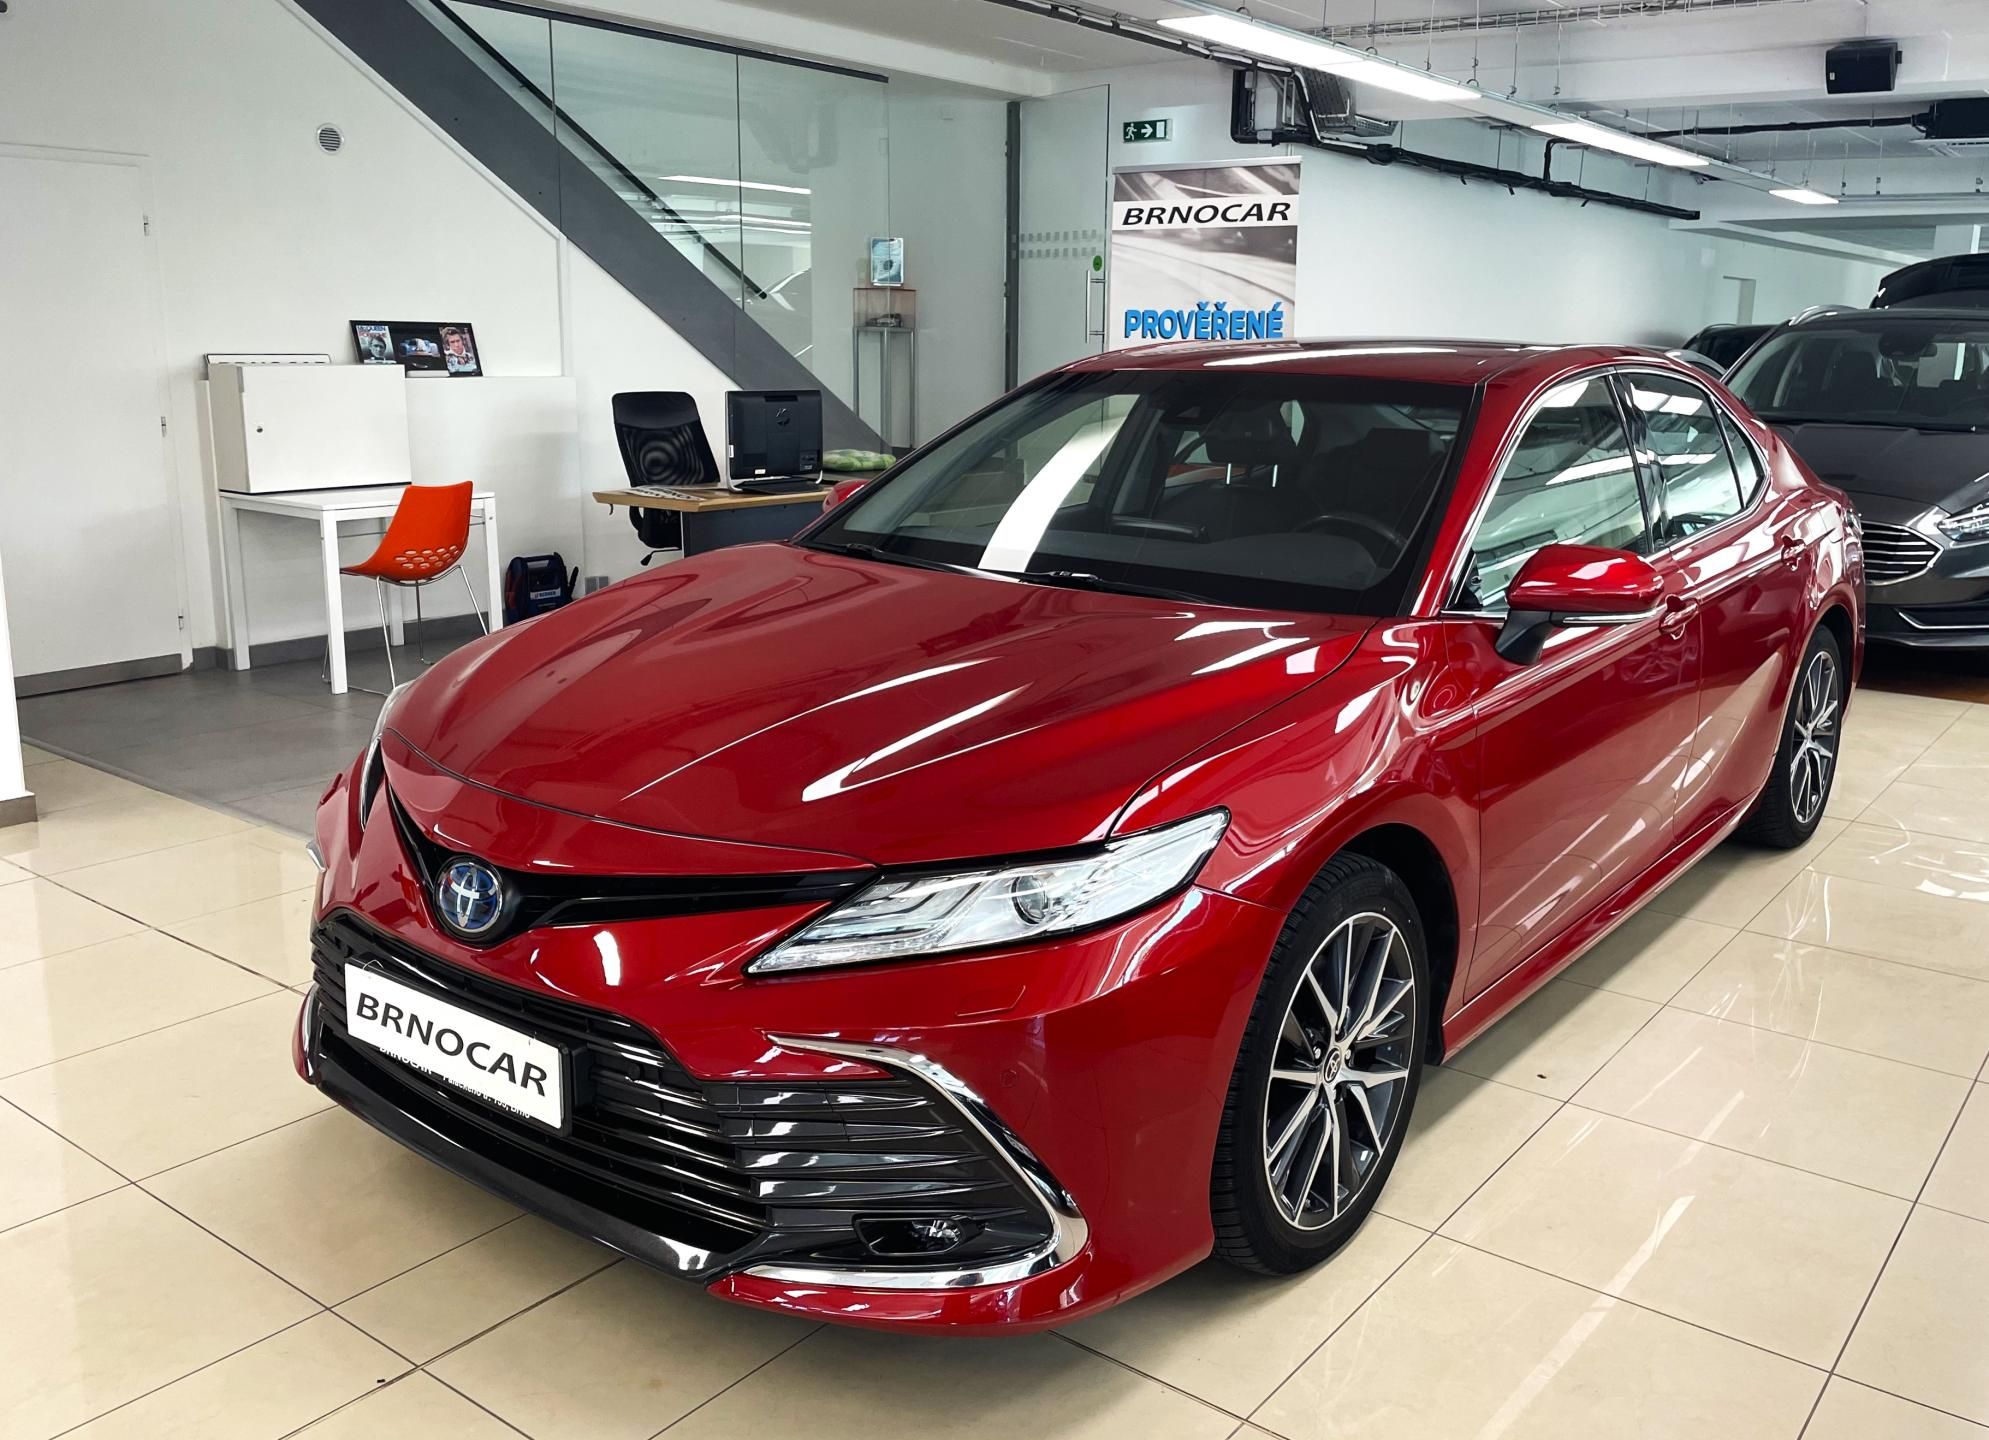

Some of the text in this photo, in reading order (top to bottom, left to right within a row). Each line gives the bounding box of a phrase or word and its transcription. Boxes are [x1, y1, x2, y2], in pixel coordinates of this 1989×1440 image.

[1122, 202, 1291, 226] BRNOCAR
[1124, 301, 1284, 340] PROVĚŘENÉ
[356, 992, 548, 1098] BRNOCAR
